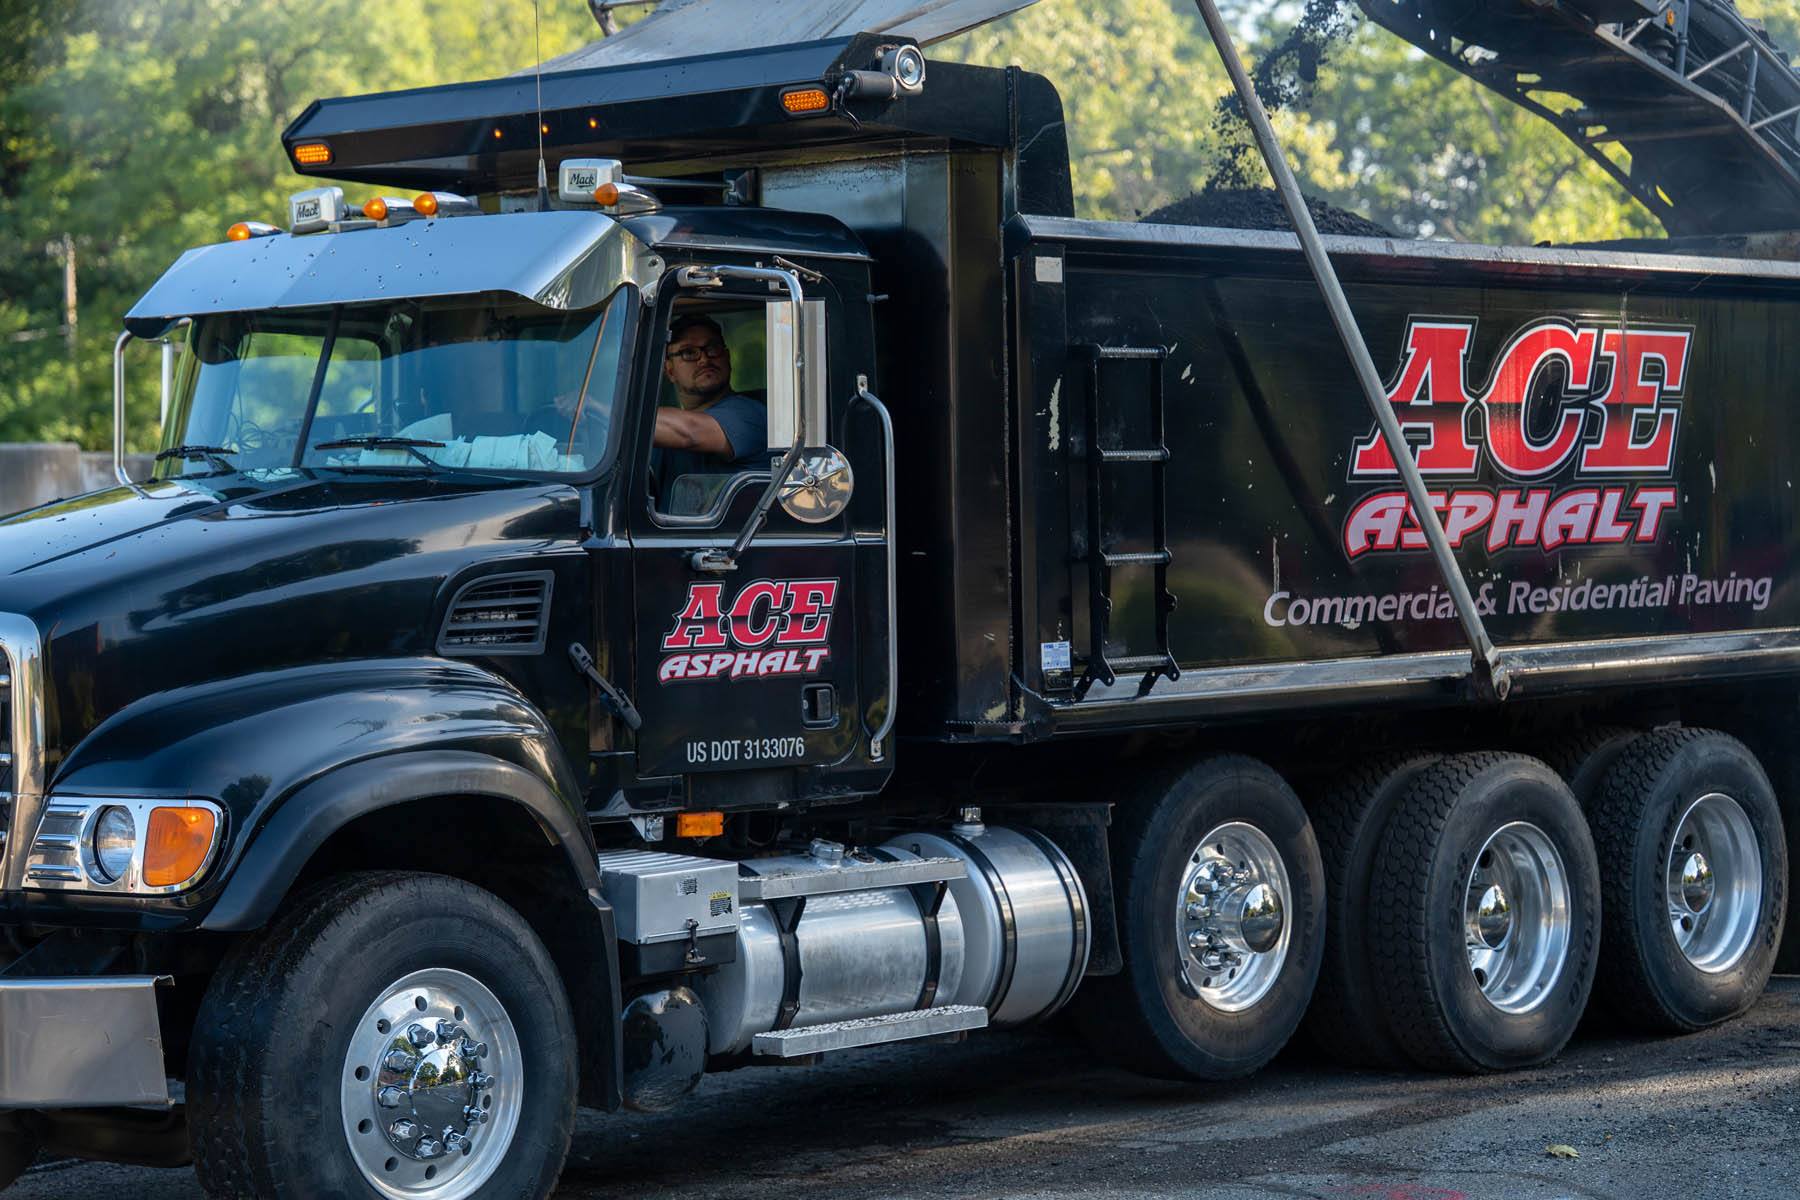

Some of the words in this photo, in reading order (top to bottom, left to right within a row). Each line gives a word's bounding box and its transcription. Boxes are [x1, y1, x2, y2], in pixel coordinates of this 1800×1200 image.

[569, 173, 595, 188] Mack
[295, 202, 319, 223] Mack
[1352, 321, 1691, 476] ACE
[1345, 488, 1677, 557] ASPHALT
[662, 579, 838, 649] ACE
[1264, 584, 1459, 628] Commercia
[1475, 582, 1497, 616] &
[1507, 575, 1673, 616] Residential
[1678, 571, 1772, 611] Paving
[658, 648, 830, 682] ASPHALT
[686, 742, 707, 763] US
[711, 740, 741, 761] DOT
[744, 737, 805, 760] 3133076
